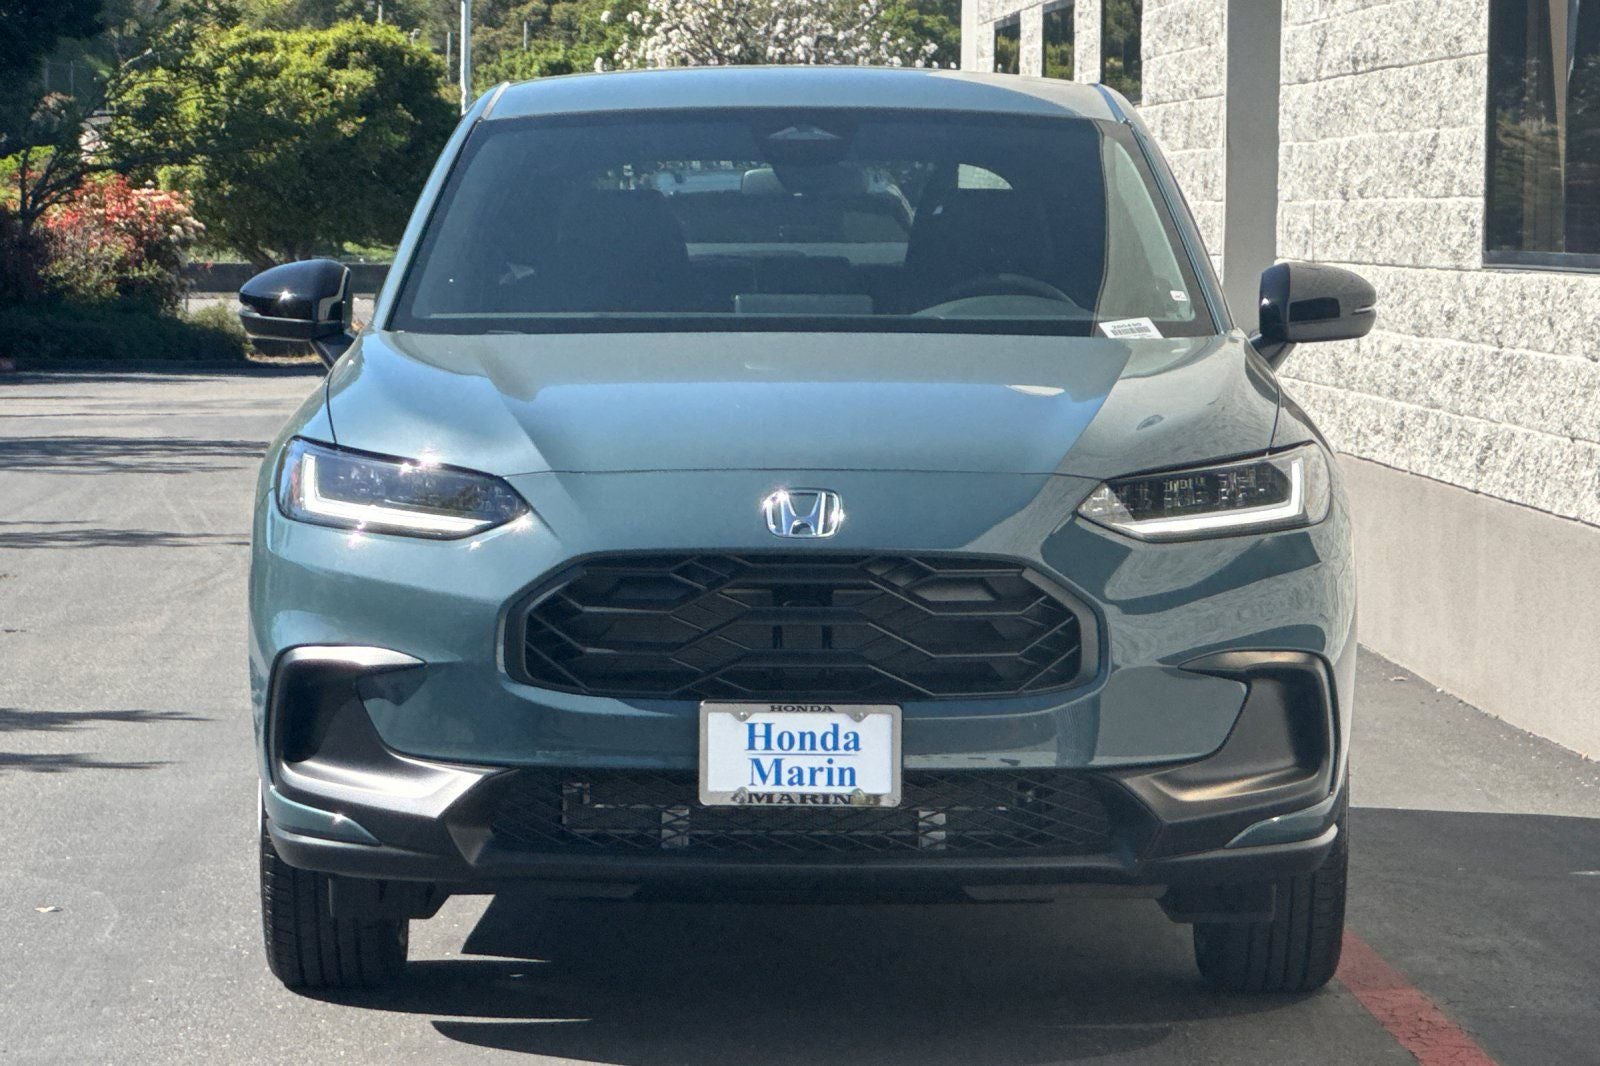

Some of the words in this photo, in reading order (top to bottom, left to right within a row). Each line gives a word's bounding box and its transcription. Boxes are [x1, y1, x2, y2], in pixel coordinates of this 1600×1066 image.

[745, 722, 862, 752] Honda
[748, 757, 857, 787] Marin
[747, 793, 852, 805] MARIN
